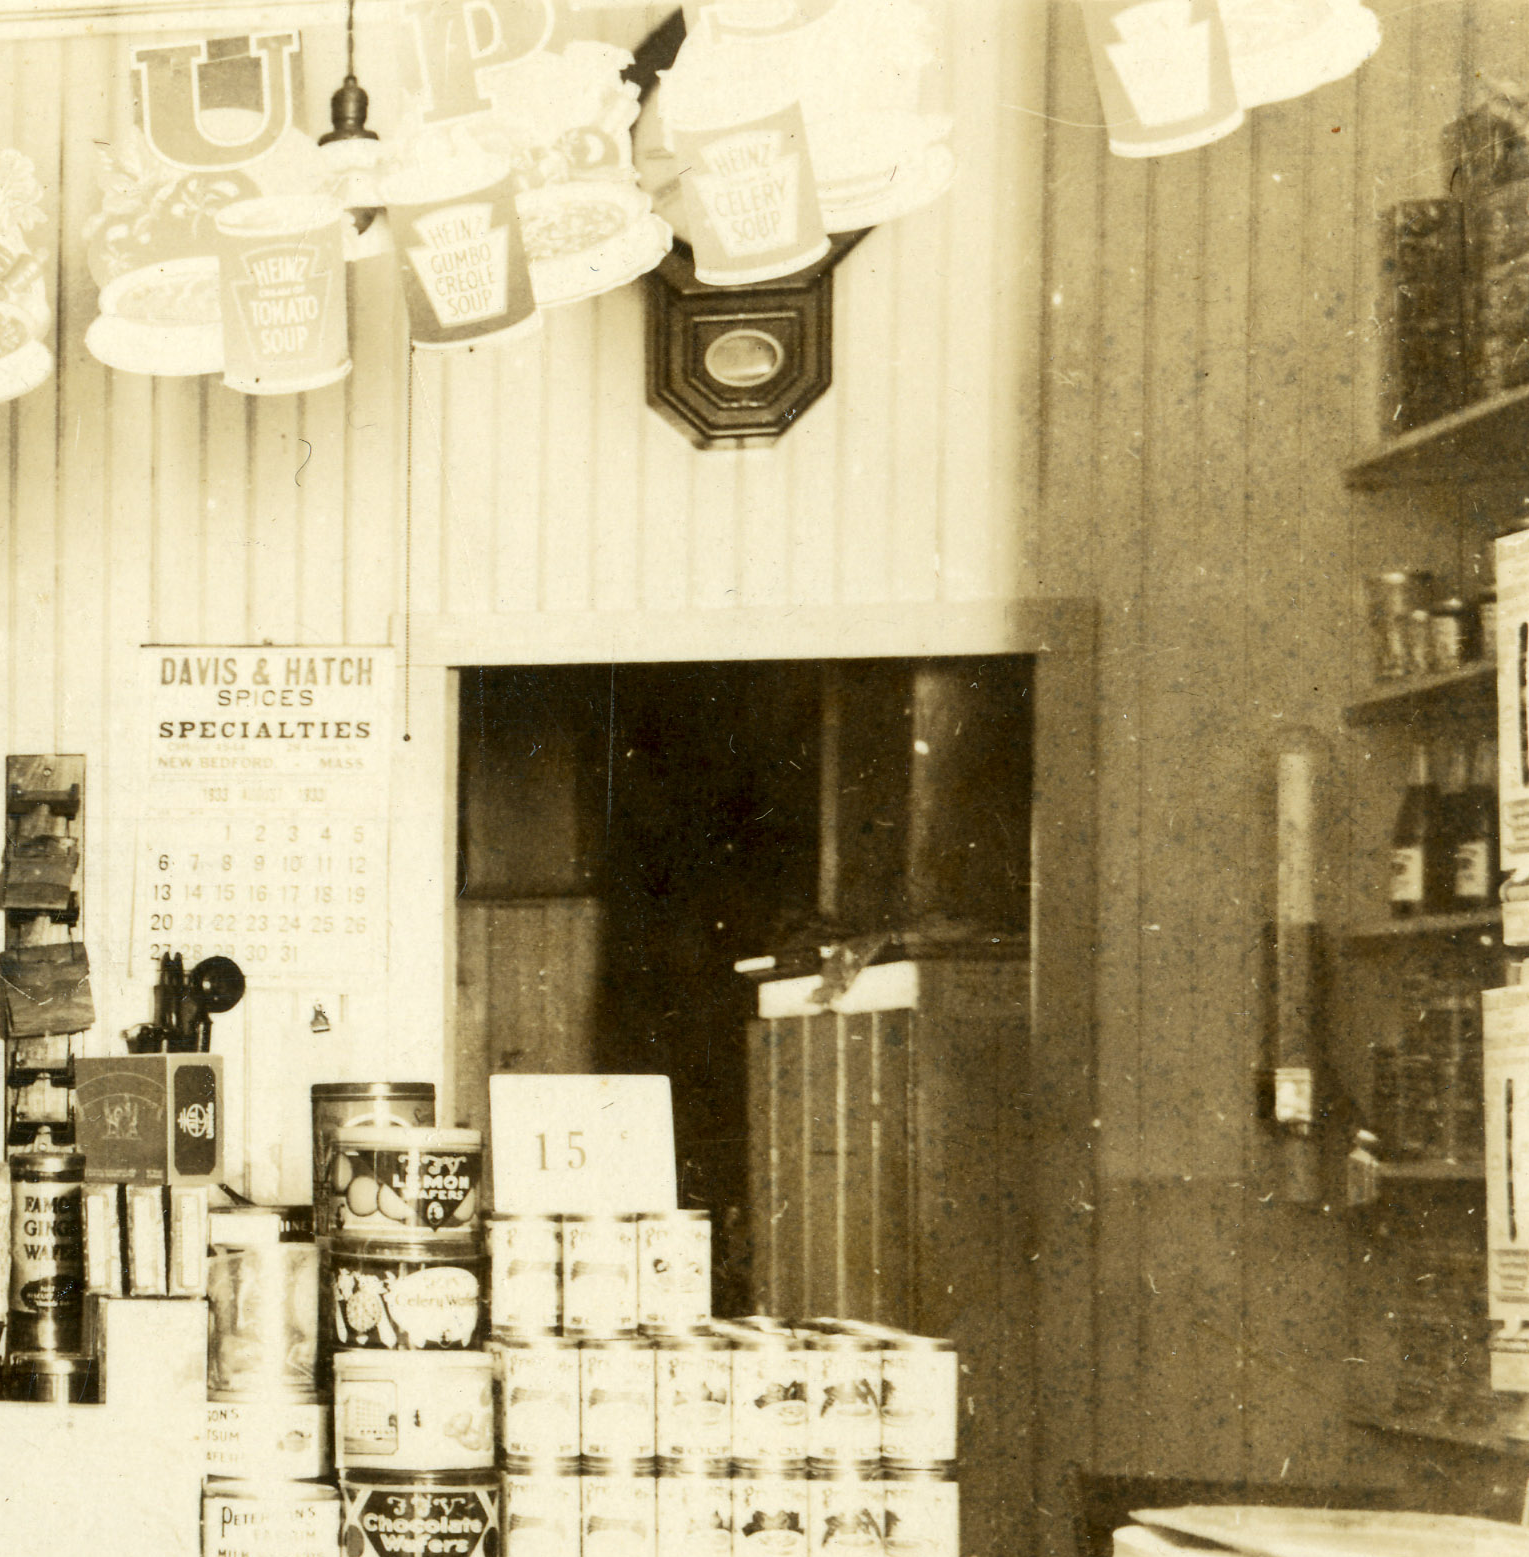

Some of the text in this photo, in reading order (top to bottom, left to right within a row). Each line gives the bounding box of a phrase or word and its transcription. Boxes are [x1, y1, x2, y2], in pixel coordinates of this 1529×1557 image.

[713, 143, 773, 178] HEINZ
[714, 178, 787, 218] CELERY
[428, 217, 483, 250] HEINZ
[730, 210, 783, 243] SOUP
[252, 255, 310, 288] HEINZ
[429, 245, 492, 275] GUMBO
[433, 268, 497, 298] CREOLE
[251, 299, 319, 326] TOMATO
[446, 289, 493, 318] SOUP
[260, 328, 308, 355] SOUP
[160, 656, 374, 687] DAVIS & HATCH
[217, 689, 315, 707] SPICES
[159, 721, 373, 739] SPECIALTIES
[157, 757, 365, 770] NEW MASS
[254, 825, 365, 844] 2 3 4 5
[158, 854, 367, 874] 6 8 9 12
[152, 884, 366, 904] 13 14 15 16 17 18 19
[150, 913, 367, 934] 20 22 23 24 25 26
[245, 944, 299, 962] 30 31
[535, 1130, 588, 1172] 15
[394, 1294, 444, 1309] Celery
[362, 1513, 484, 1534] Chocolate
[379, 1532, 471, 1555] Wafers
